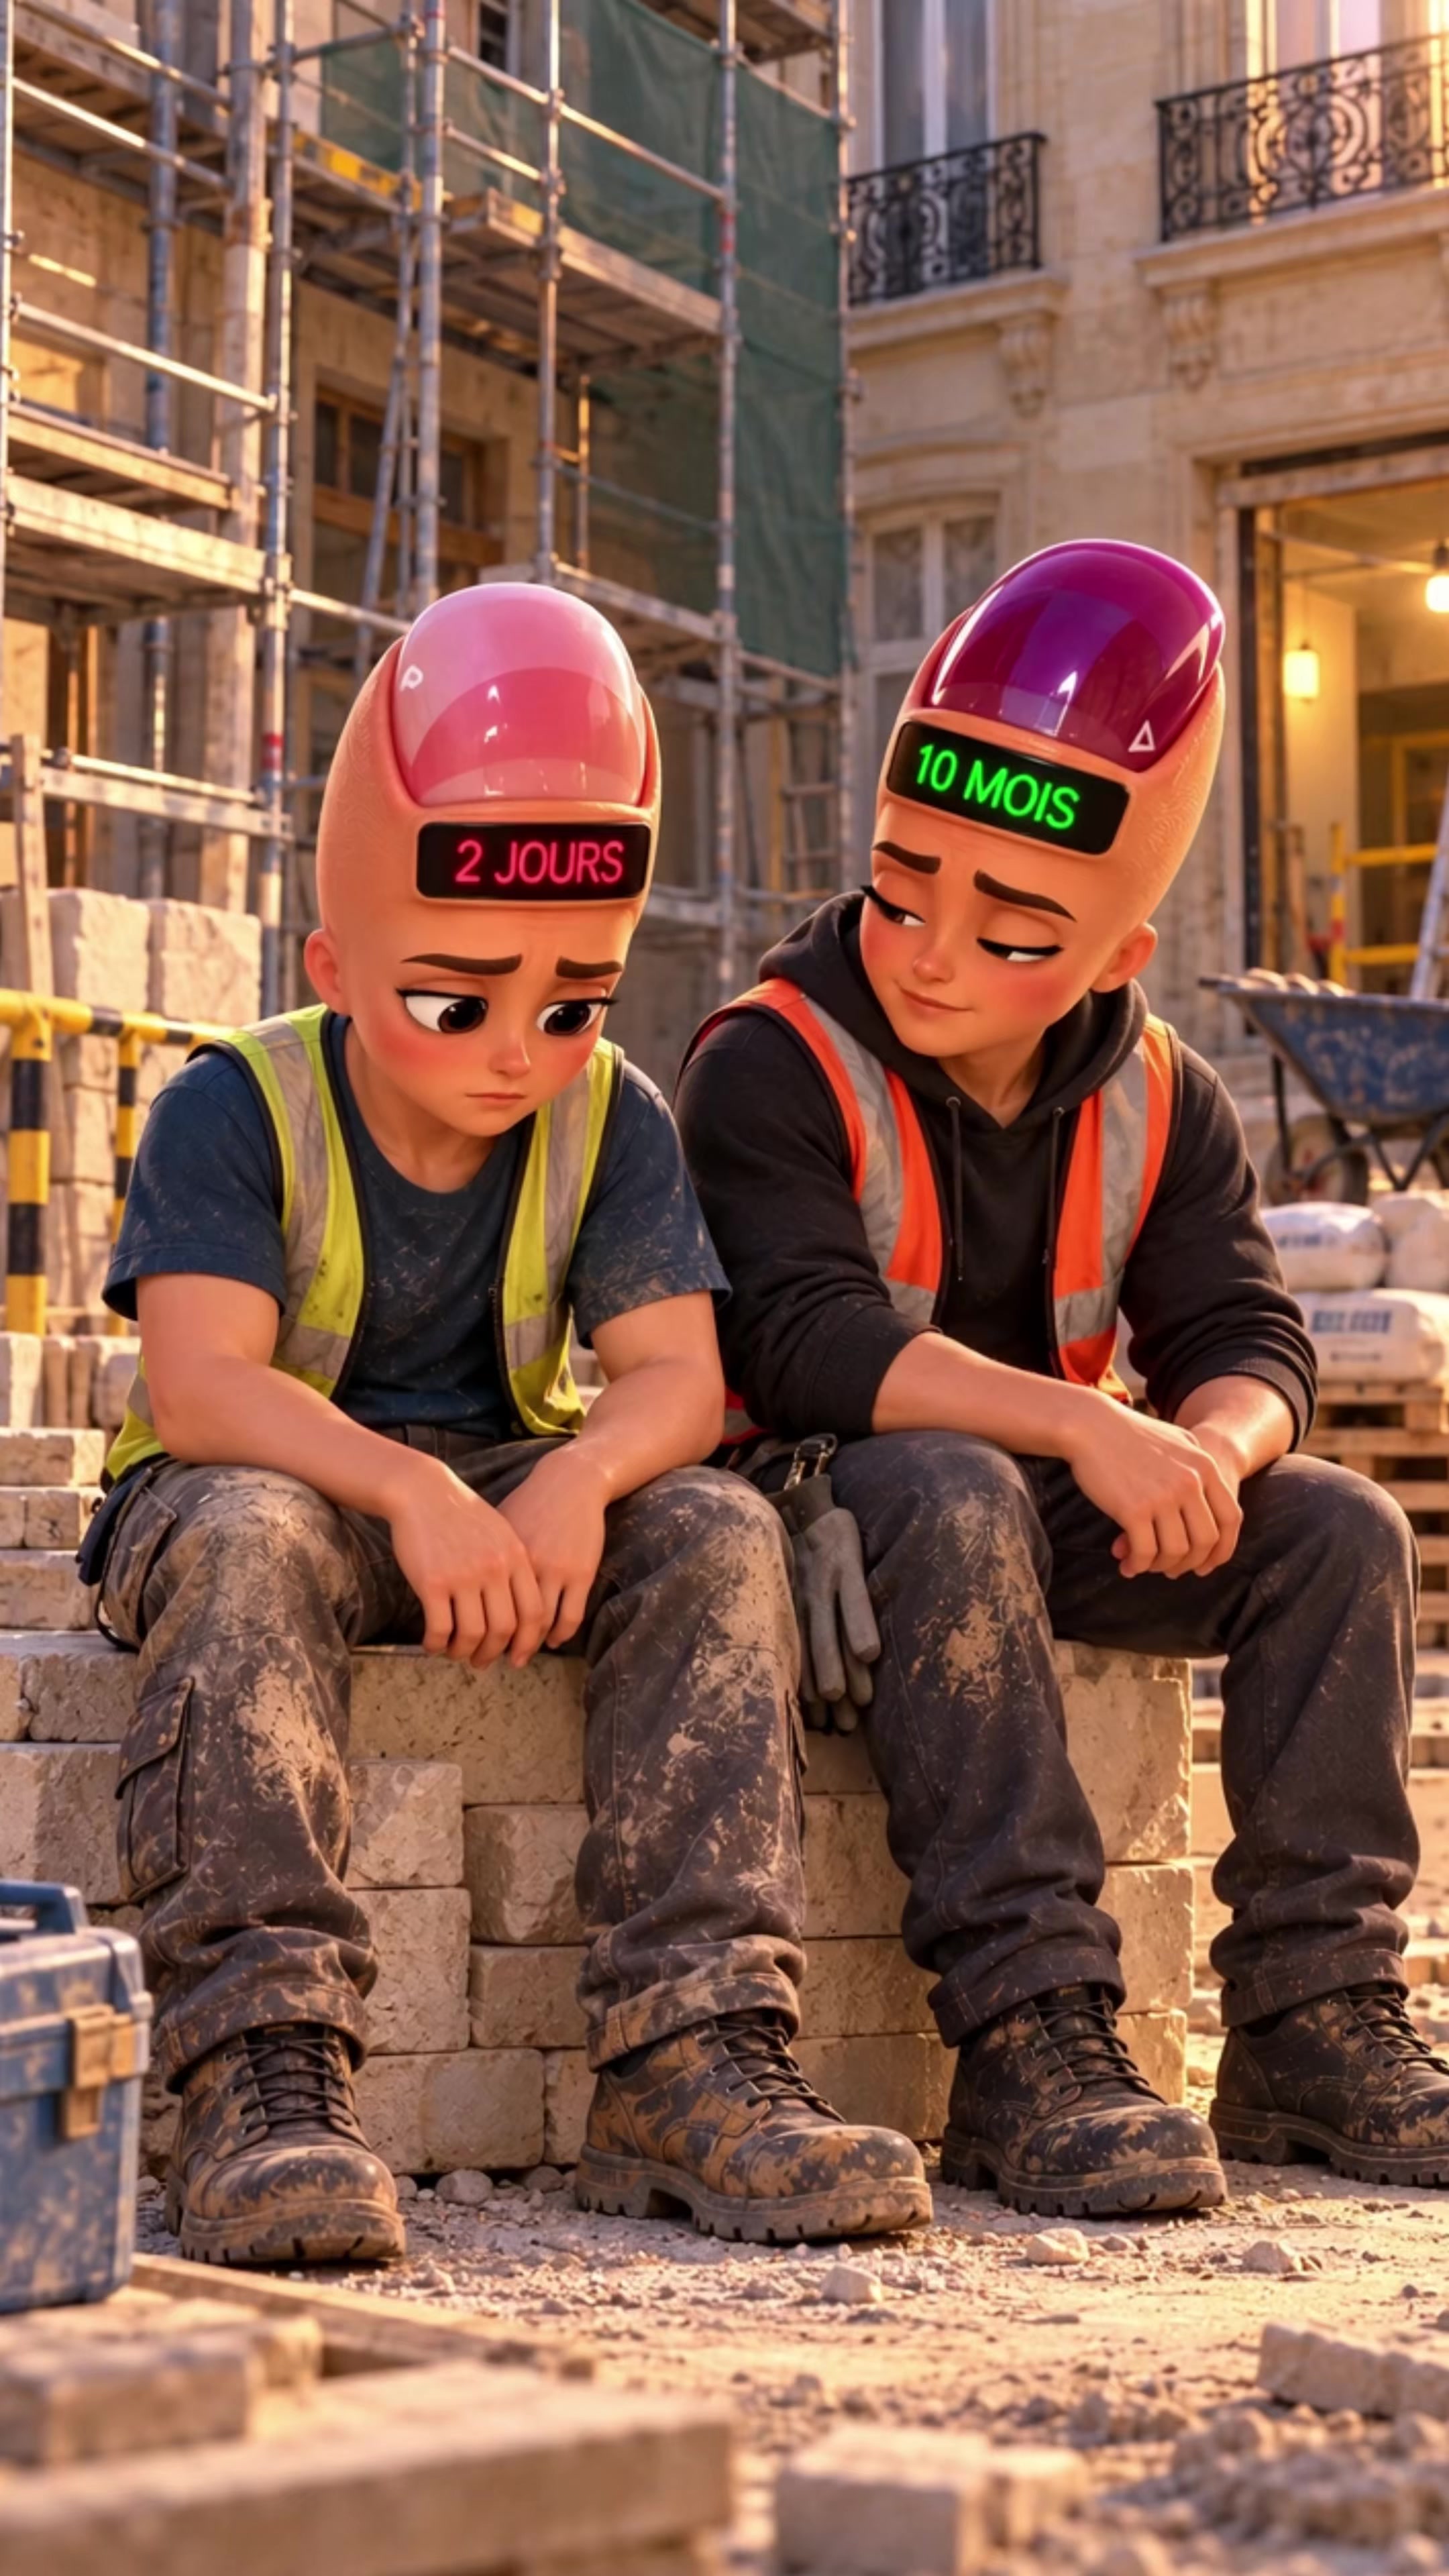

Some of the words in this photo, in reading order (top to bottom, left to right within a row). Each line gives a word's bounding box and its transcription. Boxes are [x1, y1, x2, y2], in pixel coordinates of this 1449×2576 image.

[916, 743, 959, 793] 10
[963, 759, 1081, 830] MOIS
[454, 839, 484, 883] 2
[494, 840, 625, 885] JOURS
